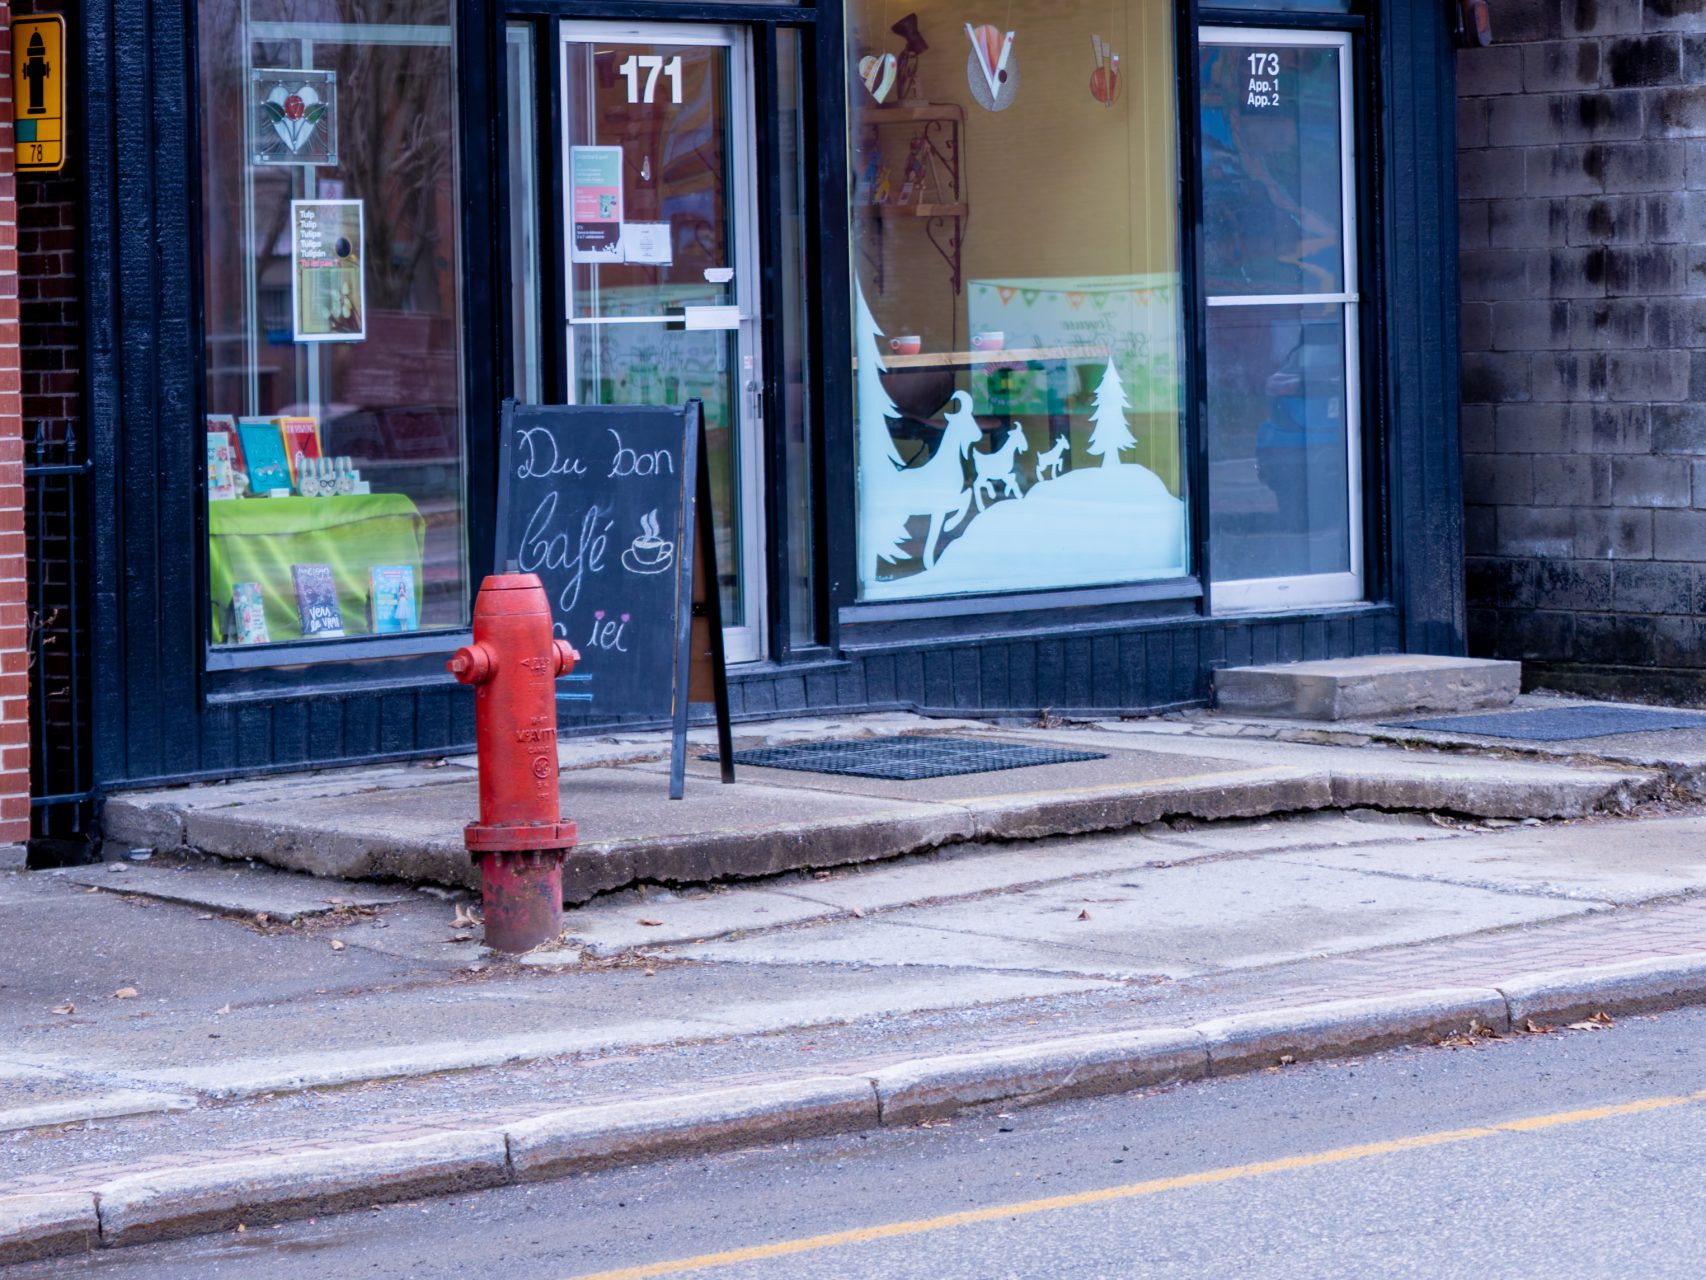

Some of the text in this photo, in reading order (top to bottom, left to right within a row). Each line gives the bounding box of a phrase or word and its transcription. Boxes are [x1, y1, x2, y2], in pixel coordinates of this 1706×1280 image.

[1248, 53, 1280, 76] 173
[619, 55, 682, 104] 171
[1248, 78, 1279, 92] App. 1
[1247, 93, 1280, 107] App. 2
[30, 144, 43, 163] 78
[517, 427, 674, 478] Du bon
